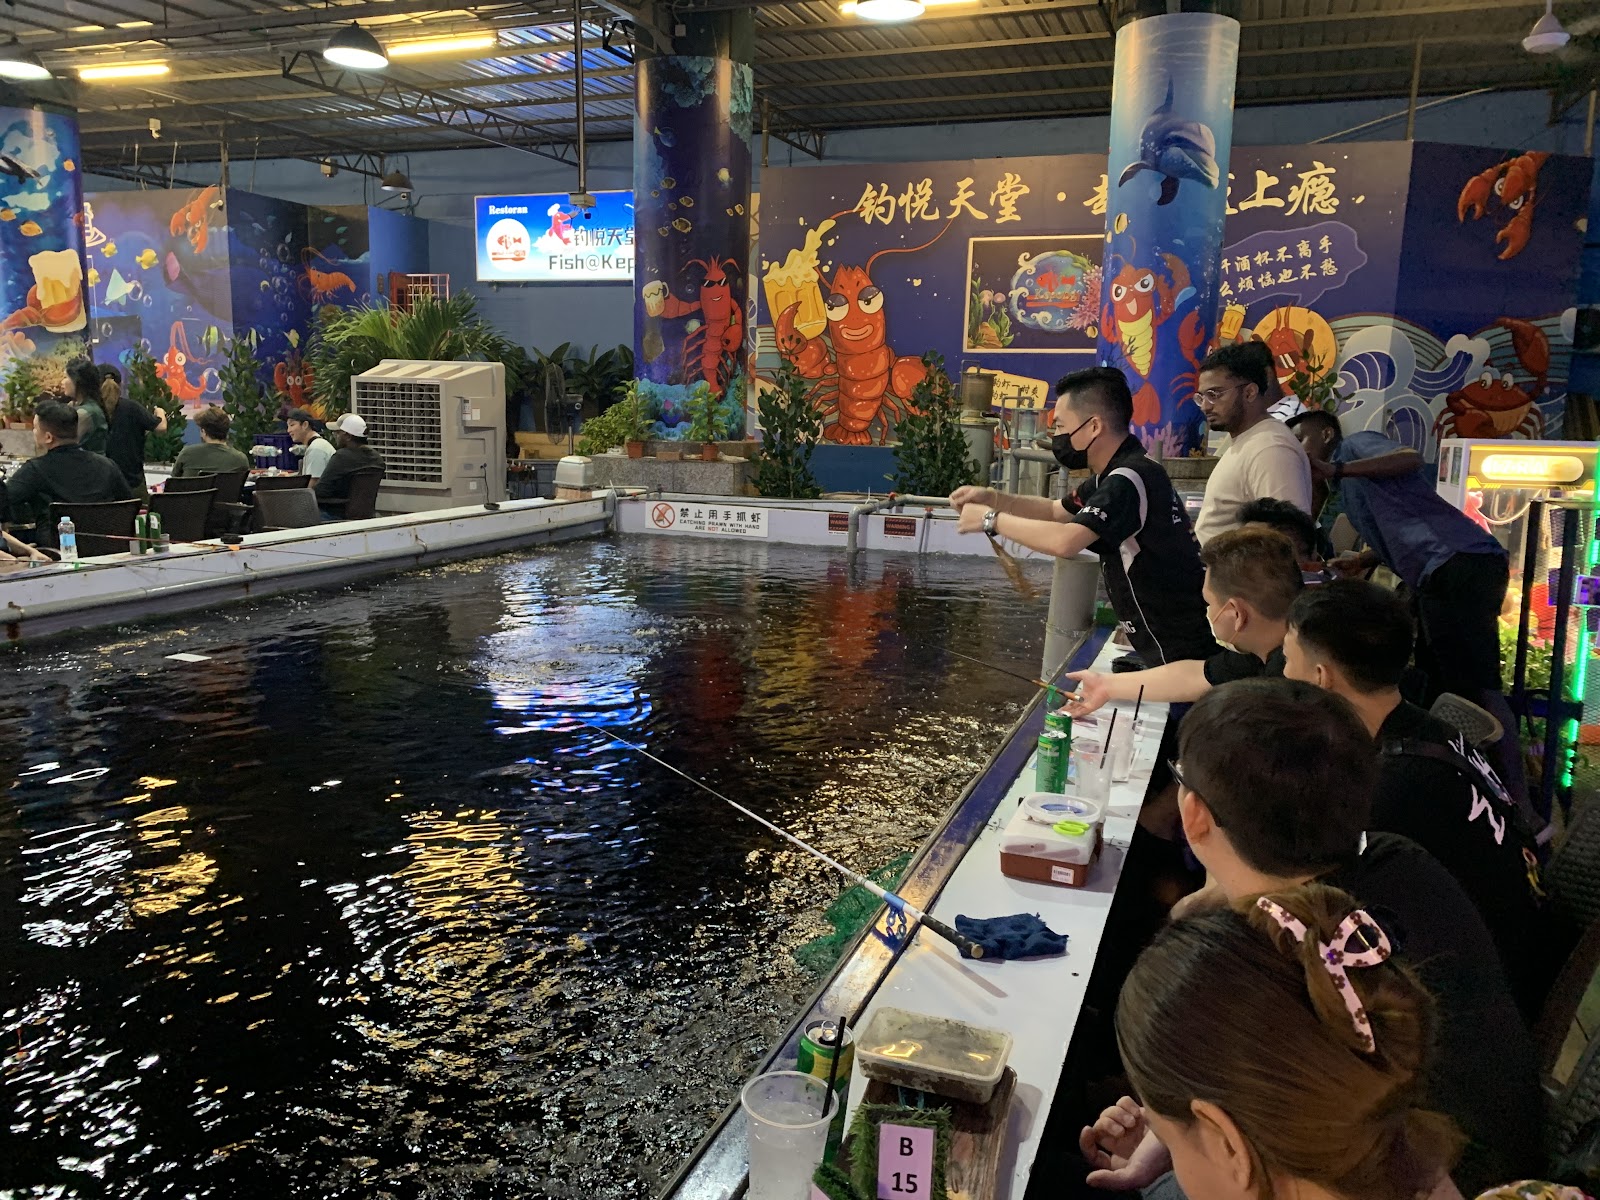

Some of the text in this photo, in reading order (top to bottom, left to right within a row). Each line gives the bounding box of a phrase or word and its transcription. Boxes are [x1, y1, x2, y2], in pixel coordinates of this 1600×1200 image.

[488, 204, 529, 215] Restoran
[680, 508, 762, 523] 禁止用手抓虾
[899, 1136, 914, 1157] B
[891, 1172, 919, 1194] 15
